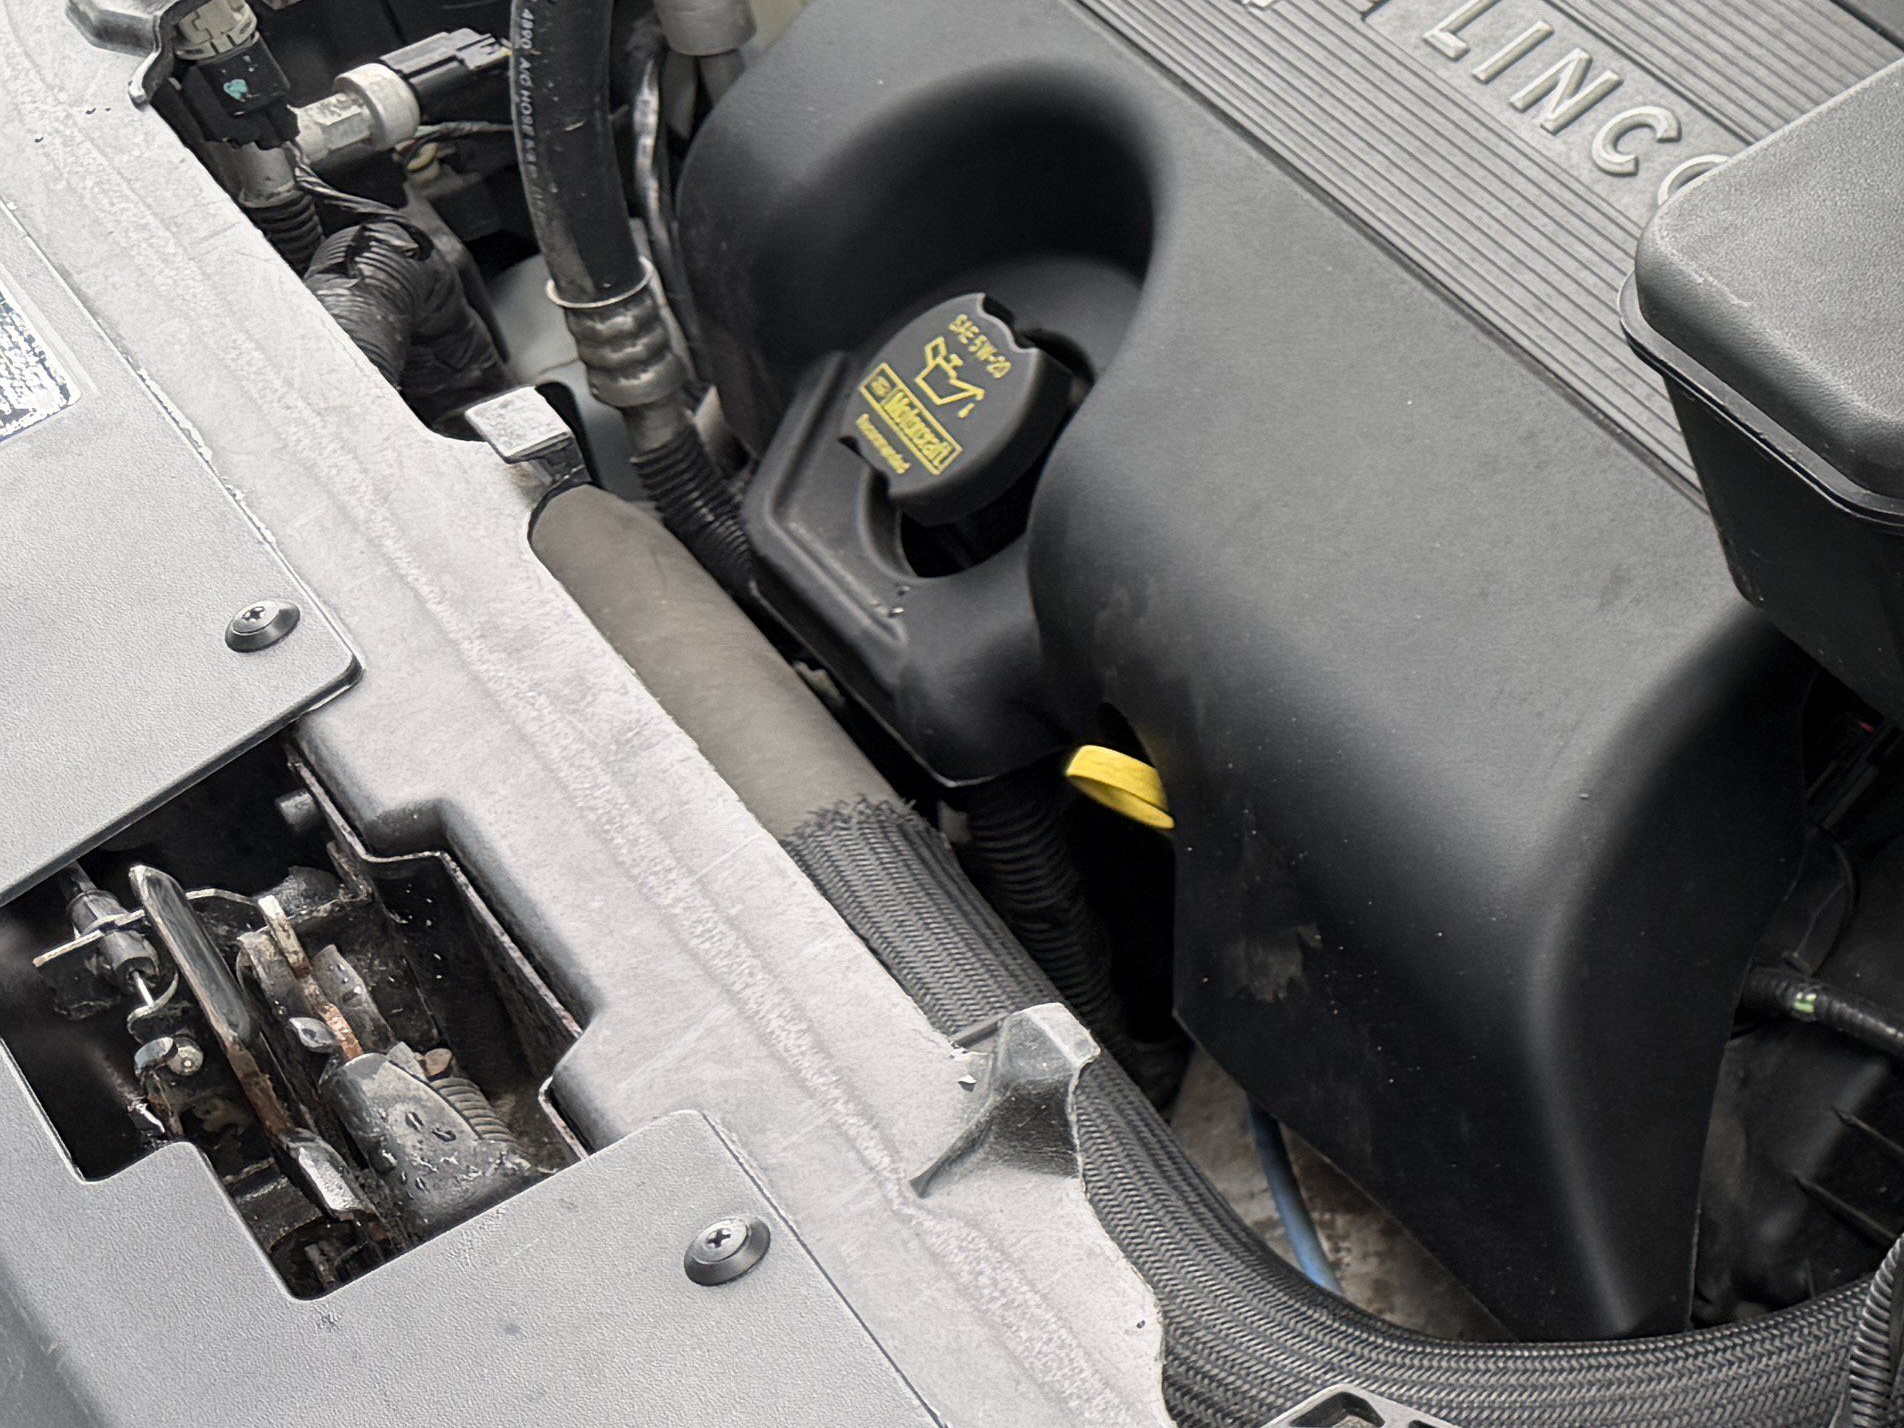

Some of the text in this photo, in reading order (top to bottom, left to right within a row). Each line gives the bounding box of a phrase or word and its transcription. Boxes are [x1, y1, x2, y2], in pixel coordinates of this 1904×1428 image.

[948, 314, 1010, 377] SAE 5W-20
[884, 387, 956, 469] Motorcraft
